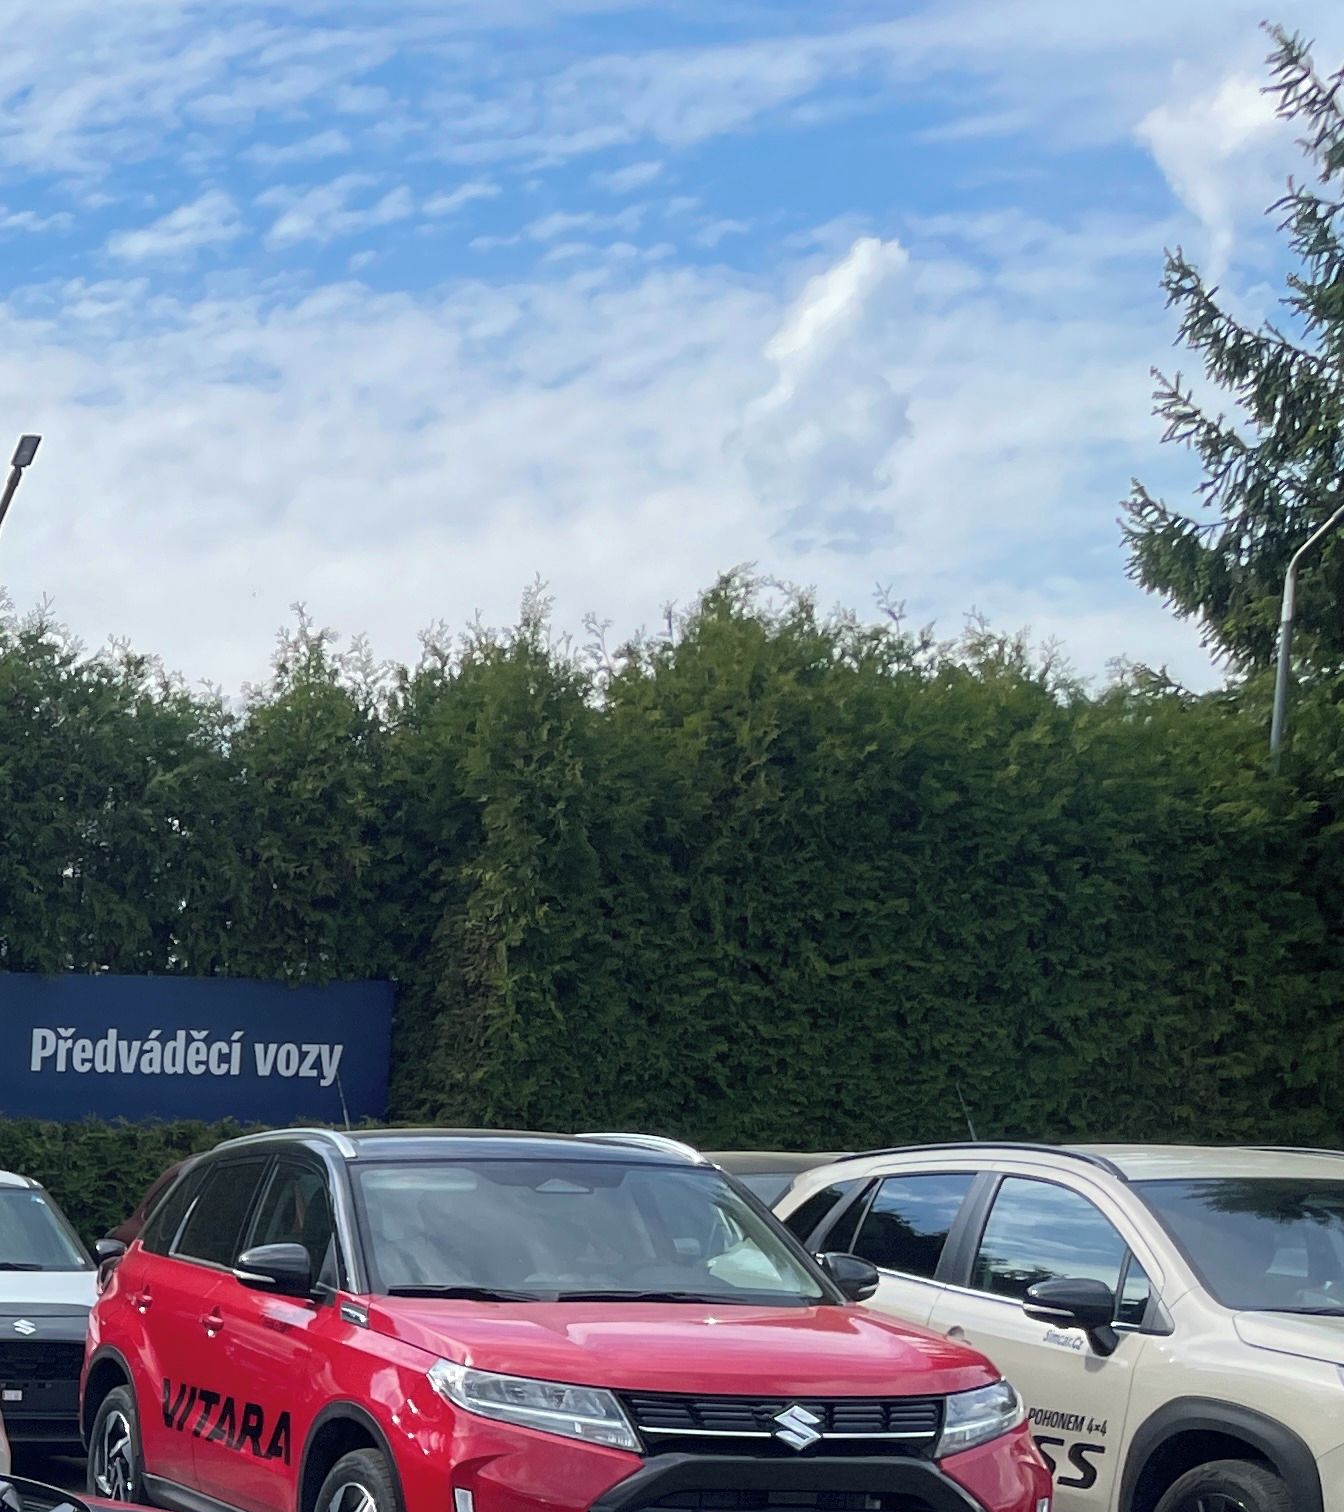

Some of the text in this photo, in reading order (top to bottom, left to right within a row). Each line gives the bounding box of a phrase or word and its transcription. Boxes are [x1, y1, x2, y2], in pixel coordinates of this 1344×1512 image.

[30, 1027, 343, 1087] Předváděcí vozy
[162, 1377, 292, 1466] VITARA
[1028, 1407, 1085, 1433] POHONEM
